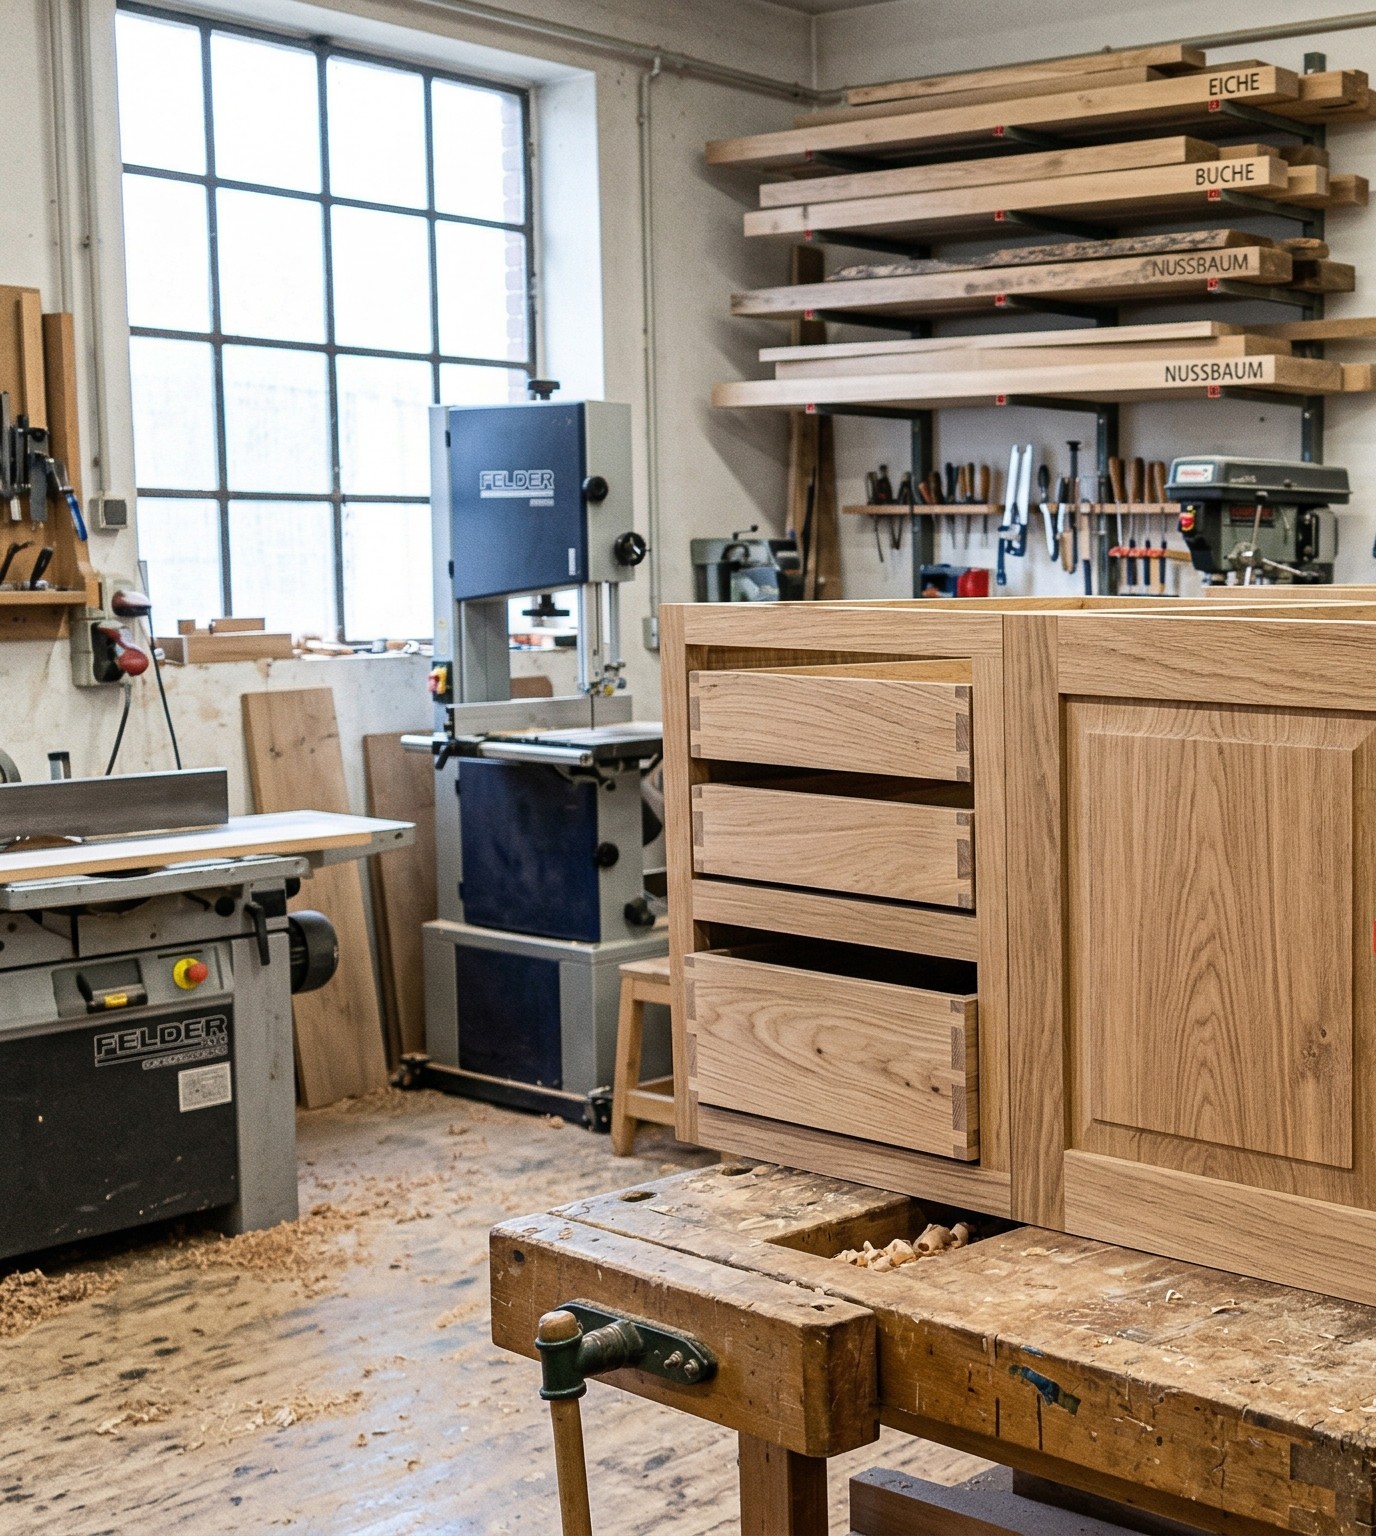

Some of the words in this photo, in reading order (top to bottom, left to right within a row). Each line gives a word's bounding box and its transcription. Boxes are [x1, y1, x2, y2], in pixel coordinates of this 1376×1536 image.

[1209, 73, 1260, 96] EICHE
[1196, 163, 1254, 186] BUCHE
[1152, 253, 1248, 277] NUSSBAUM
[1165, 361, 1263, 383] NUSSBAUM
[480, 470, 555, 490] FELDER
[94, 1014, 228, 1058] FELDER
